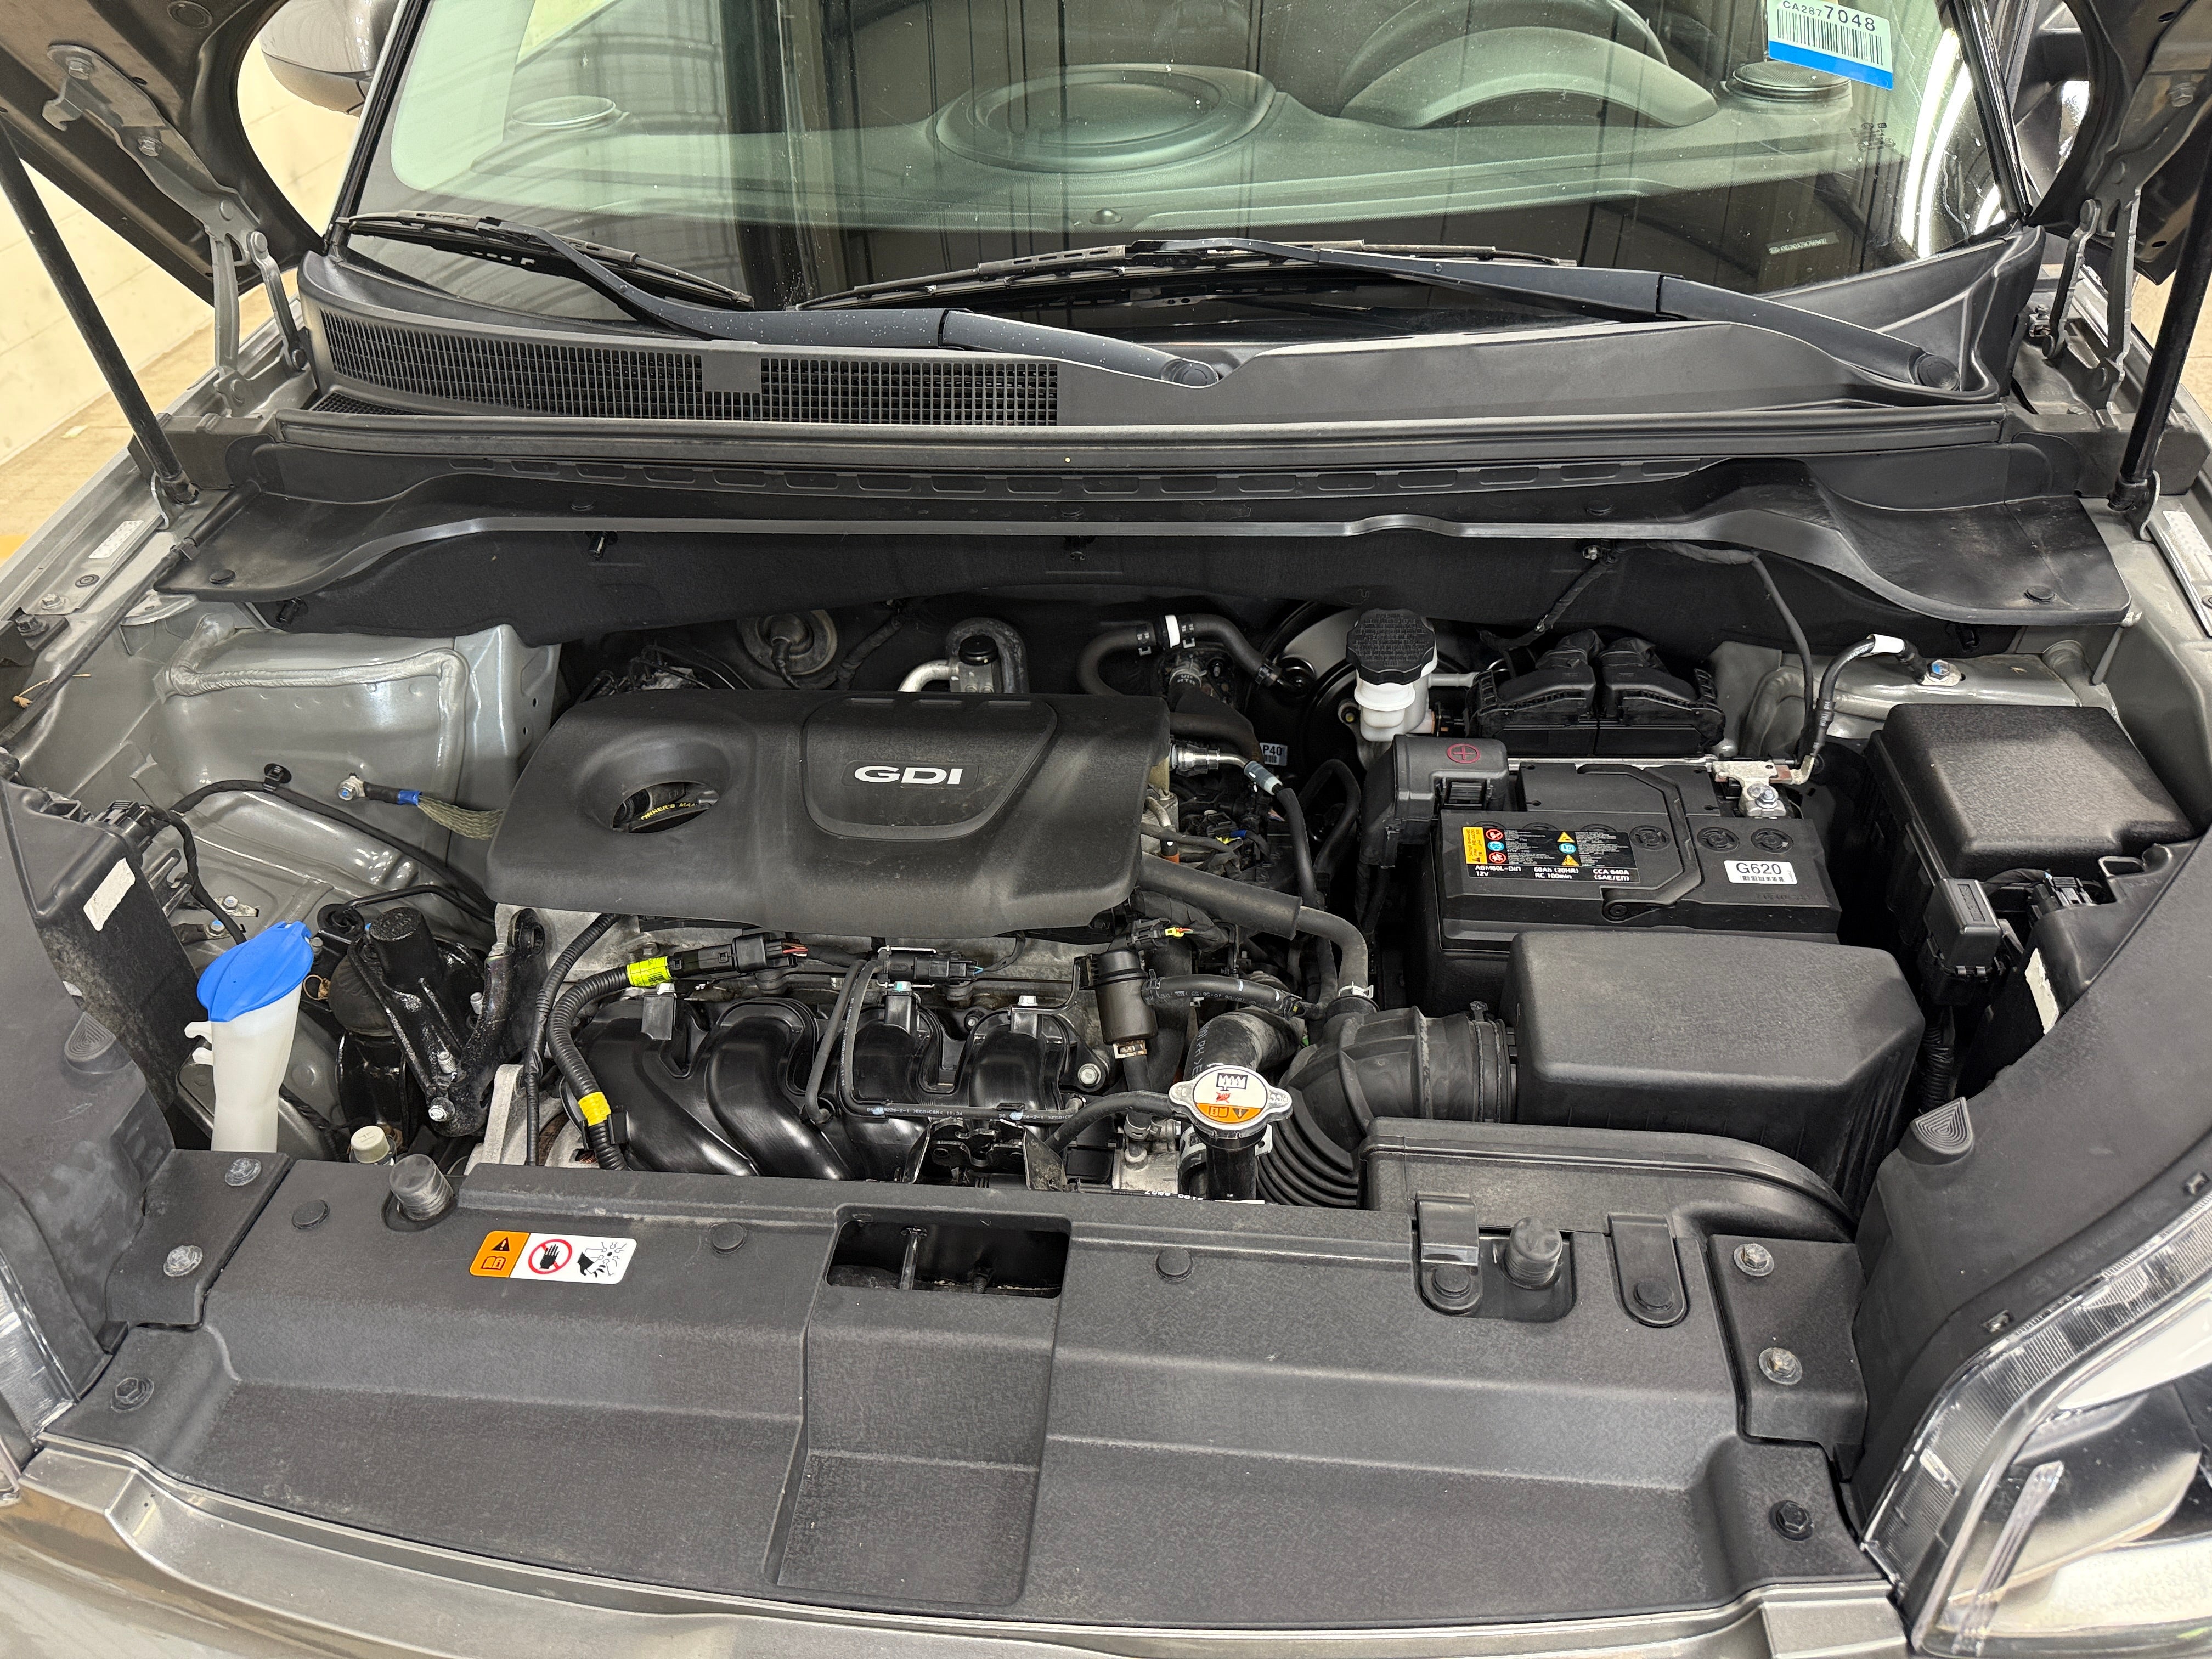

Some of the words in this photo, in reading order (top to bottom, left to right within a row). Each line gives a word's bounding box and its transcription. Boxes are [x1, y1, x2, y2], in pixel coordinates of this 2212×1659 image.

[1263, 745, 1282, 755] P40
[854, 766, 963, 785] GDI
[641, 804, 675, 820] OWNER'S
[1736, 862, 1781, 874] G620
